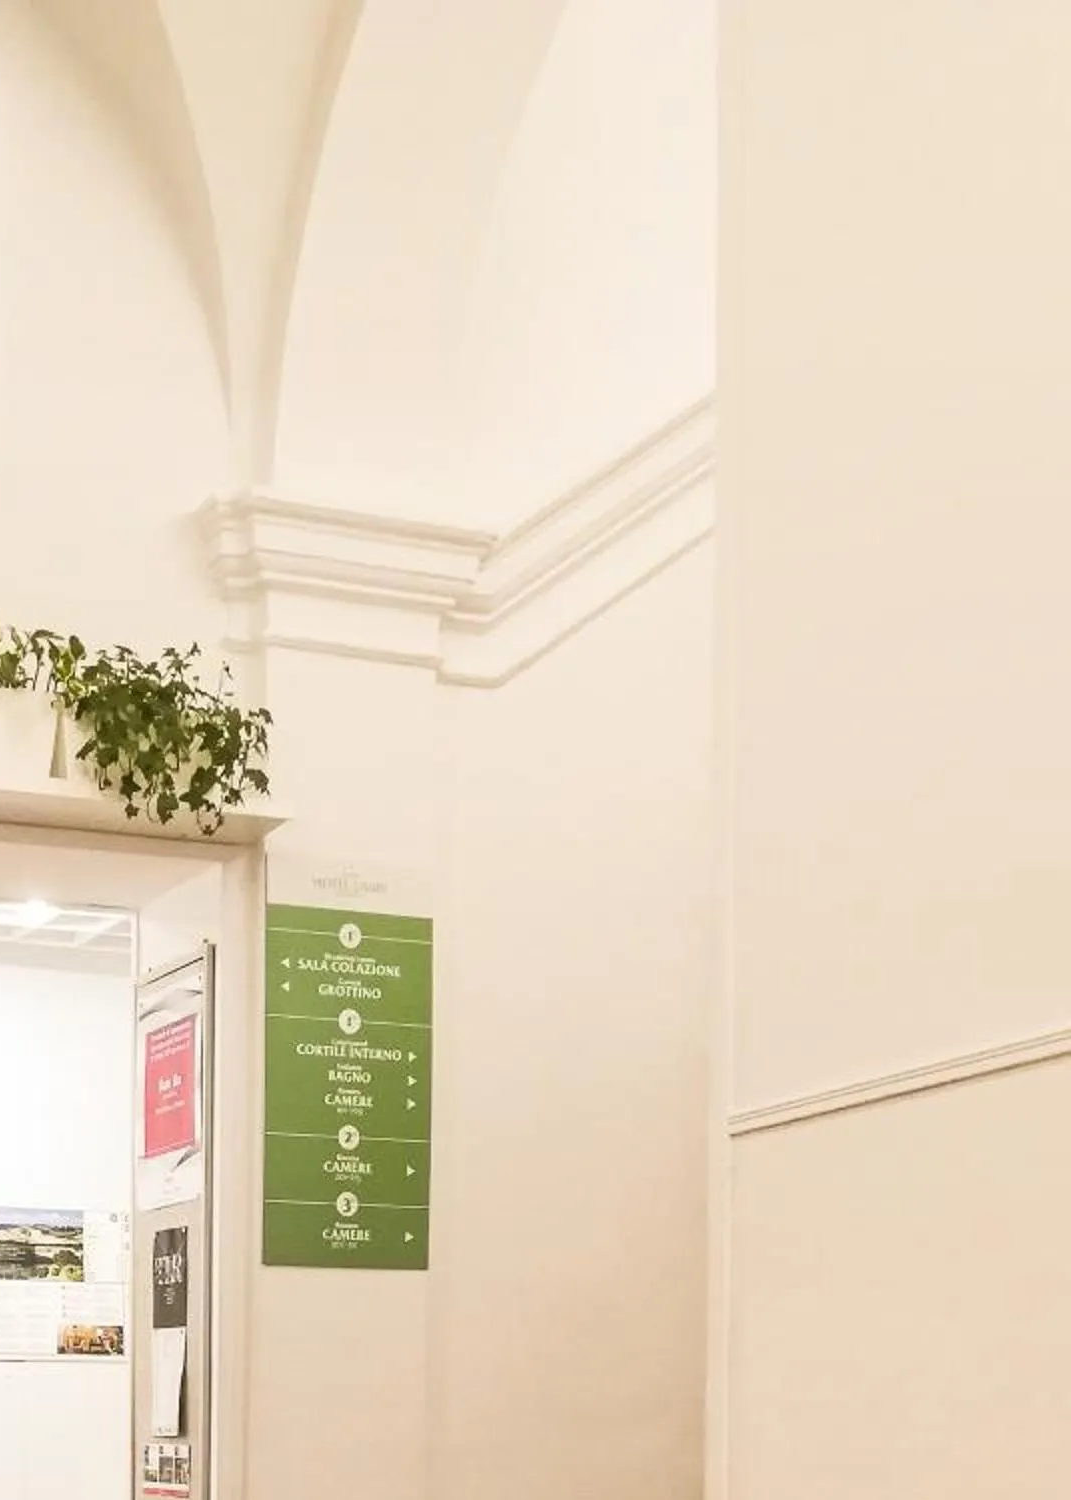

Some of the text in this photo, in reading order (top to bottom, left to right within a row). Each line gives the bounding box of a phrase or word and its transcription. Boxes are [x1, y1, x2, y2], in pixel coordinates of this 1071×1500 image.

[297, 958, 328, 972] SALA
[331, 960, 401, 977] COLAZIONE
[318, 983, 381, 999] GROTTINO
[296, 1043, 346, 1058] CORTILE
[349, 1045, 402, 1061] INTERNO
[328, 1069, 371, 1084] BAGNO
[324, 1093, 373, 1108] CAMERE
[323, 1160, 373, 1175] CAMERE
[322, 1228, 370, 1242] CAMERE
